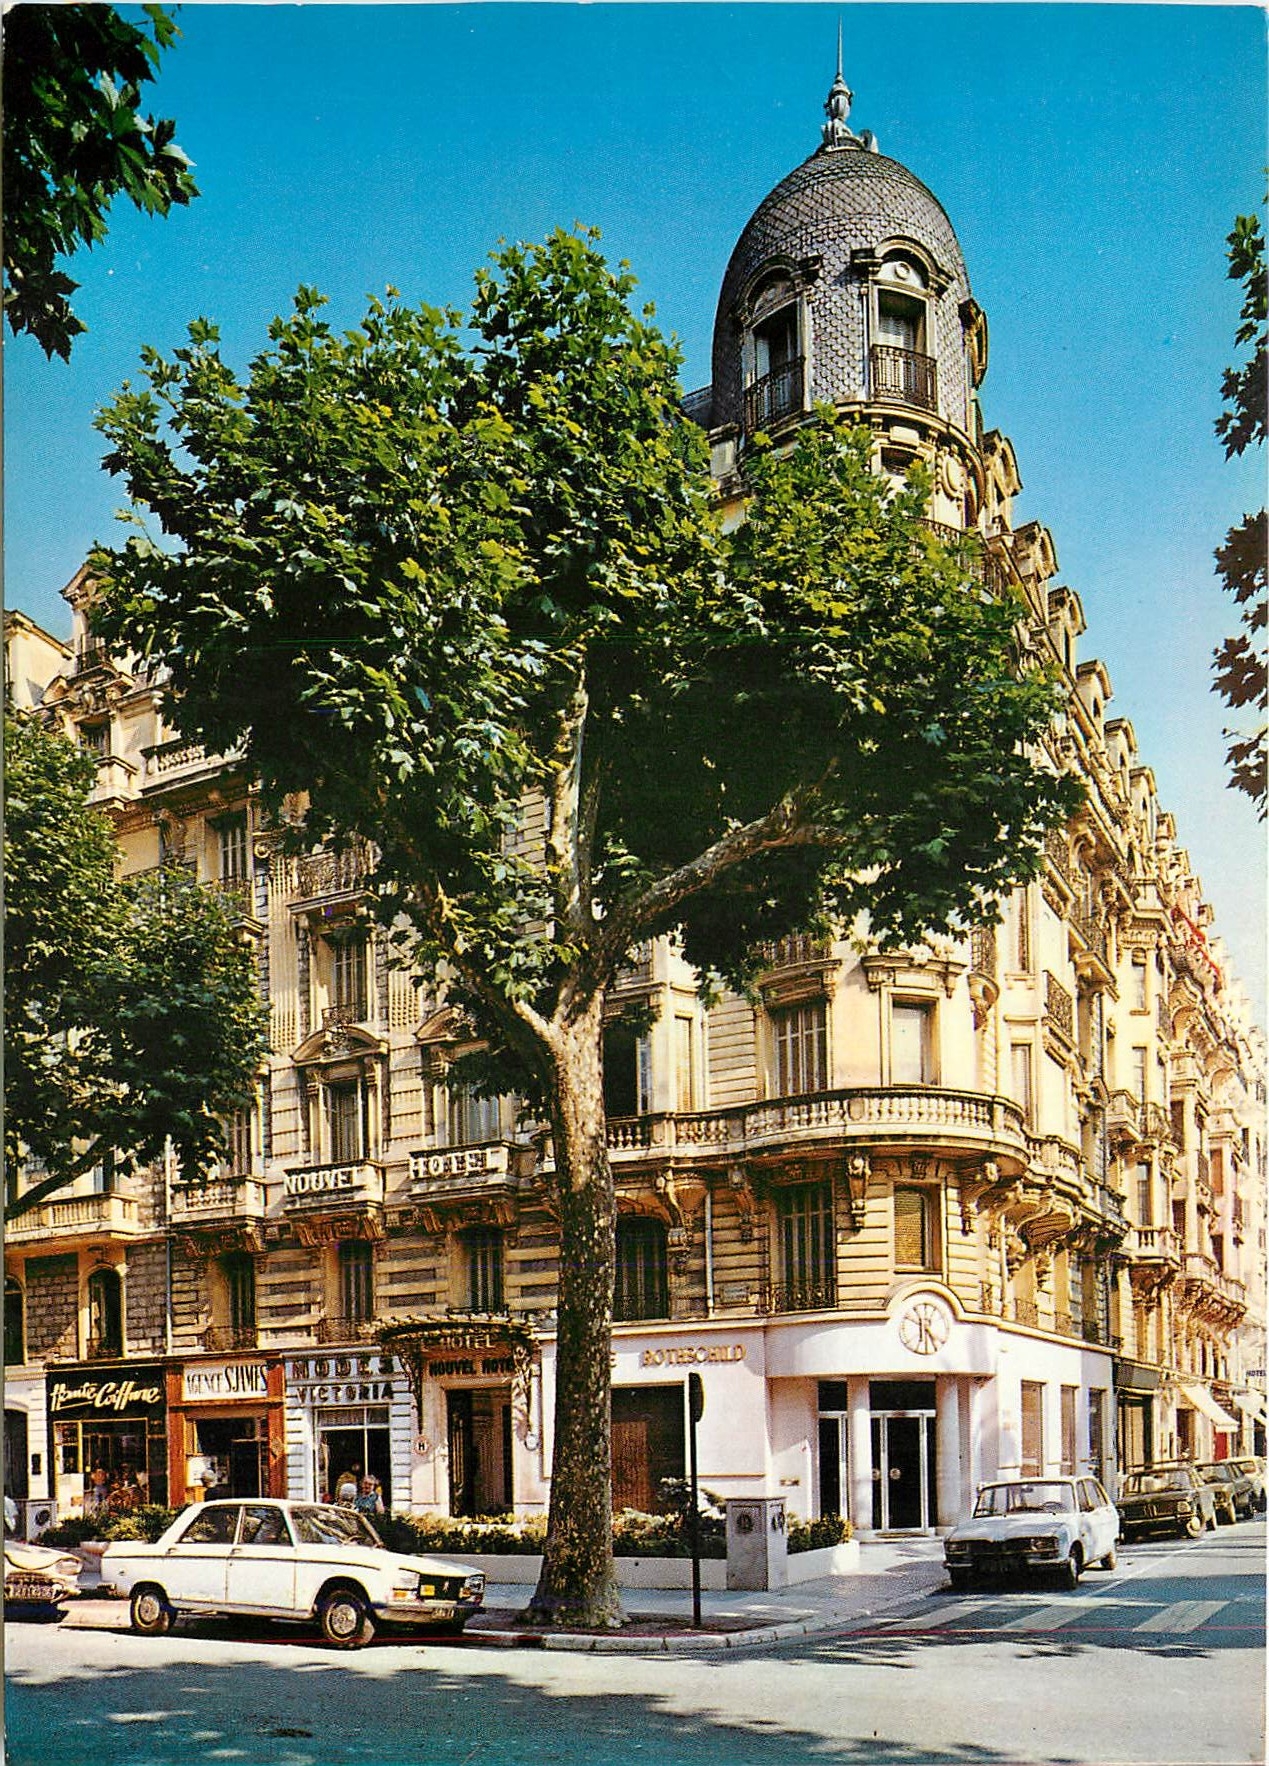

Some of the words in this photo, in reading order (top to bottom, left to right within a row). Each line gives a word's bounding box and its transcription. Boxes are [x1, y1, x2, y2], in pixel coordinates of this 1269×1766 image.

[409, 1148, 500, 1179] HOTEL
[284, 1167, 366, 1195] NOUVEL
[440, 1335, 496, 1349] HOTEL
[482, 1357, 515, 1374] HOTE
[642, 1344, 746, 1366] ROTHSCHILD
[293, 1356, 394, 1379] MODES
[50, 1382, 98, 1411] Haute
[95, 1381, 161, 1411] Coiffure
[297, 1383, 393, 1403] VICTORIA
[418, 1443, 425, 1451] H
